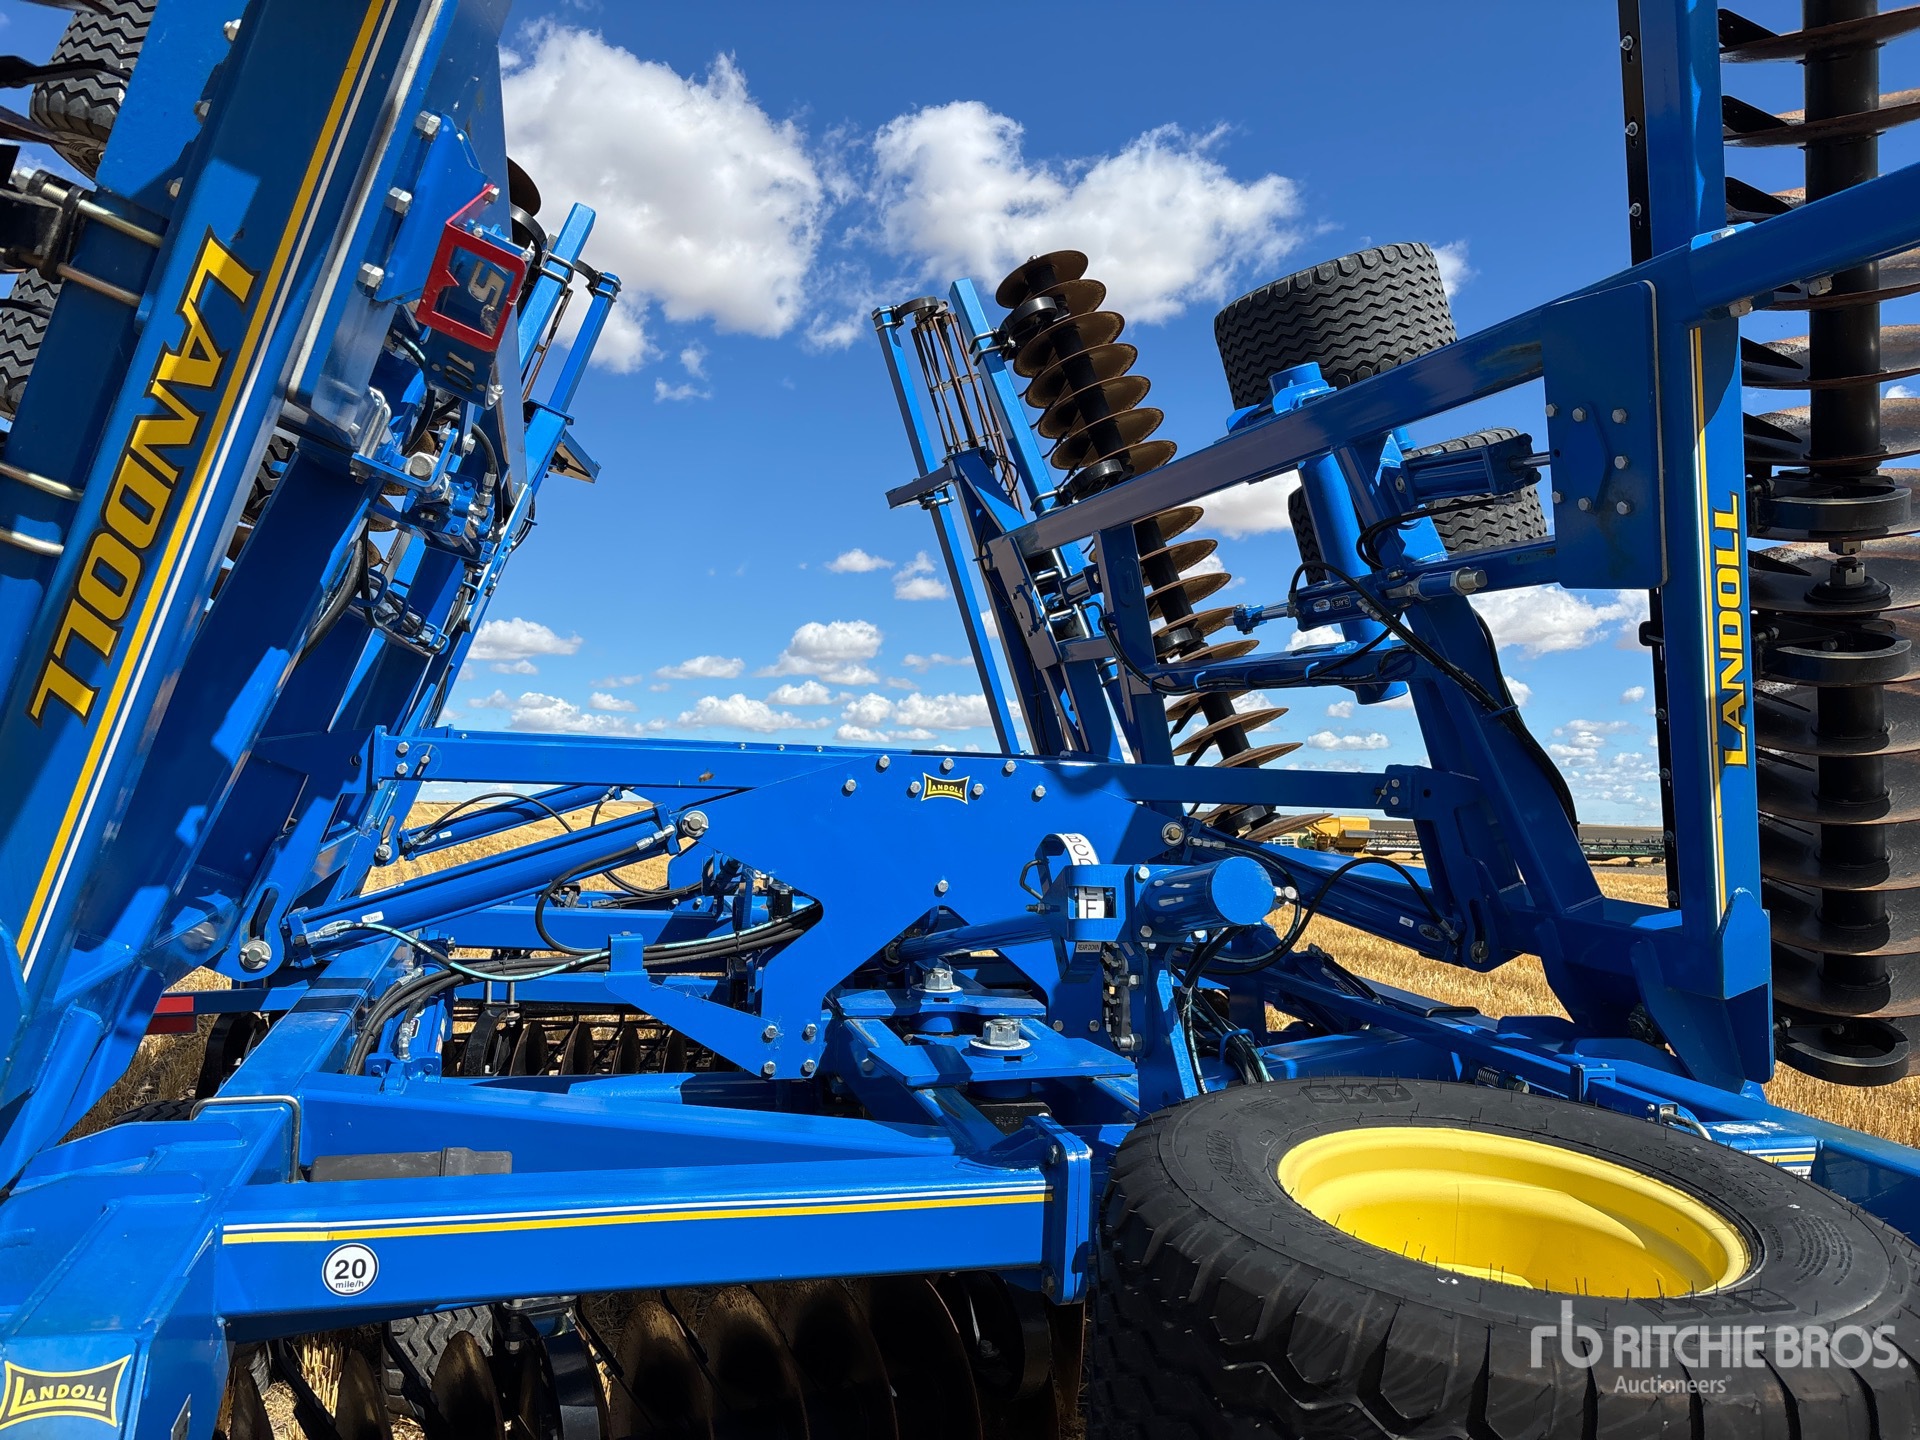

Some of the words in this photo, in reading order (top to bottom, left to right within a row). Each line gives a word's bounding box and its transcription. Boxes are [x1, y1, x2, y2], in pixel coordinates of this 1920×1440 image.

[29, 233, 257, 722] LANDOLL
[1714, 494, 1748, 766] LANDOLL
[926, 779, 964, 798] LANDOLL
[334, 1258, 367, 1280] 20
[335, 1280, 364, 1288] mile/h
[8, 1376, 107, 1416] LANDOLL
